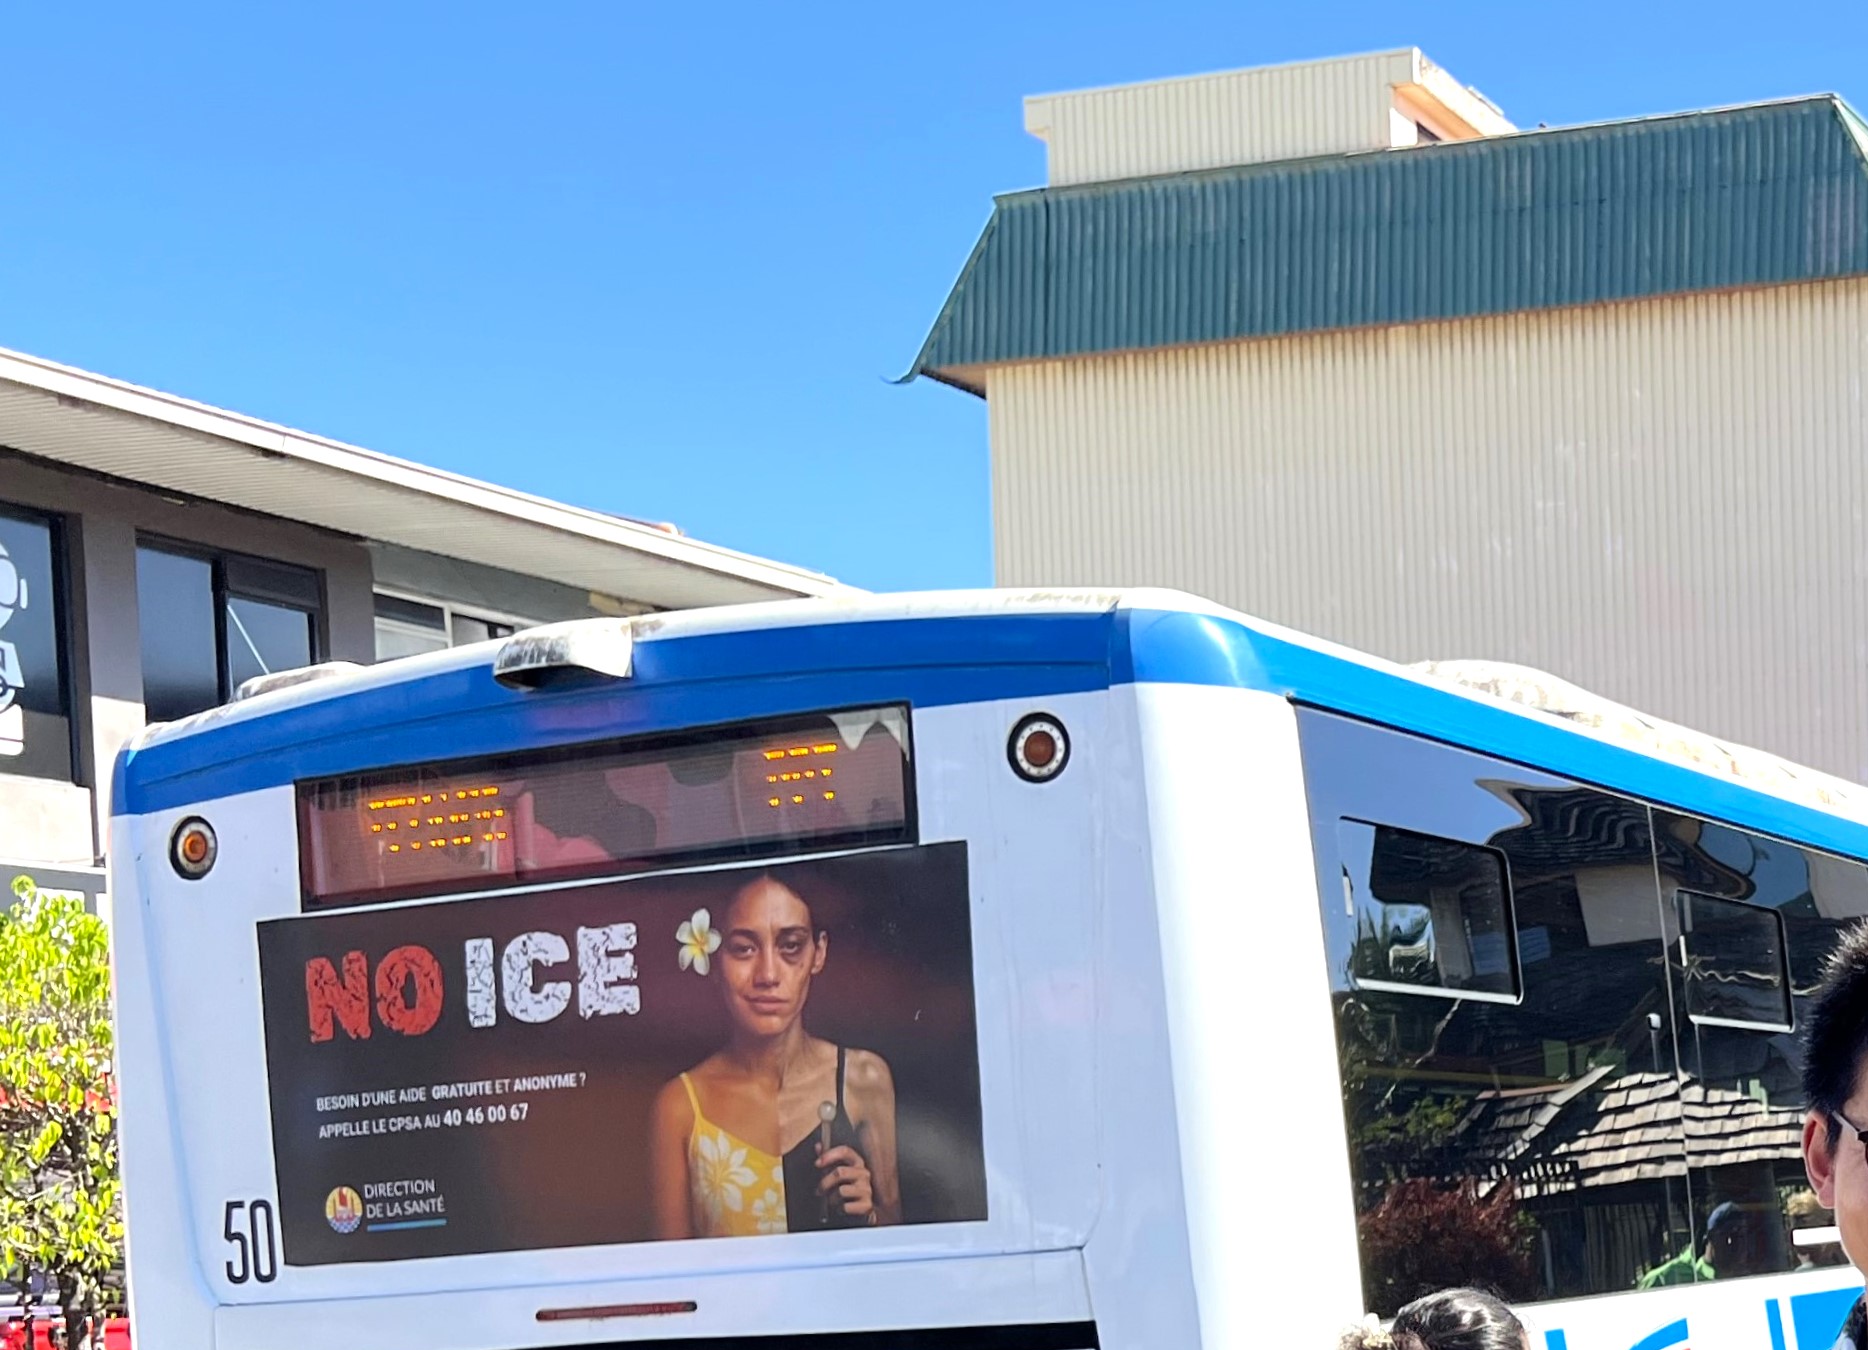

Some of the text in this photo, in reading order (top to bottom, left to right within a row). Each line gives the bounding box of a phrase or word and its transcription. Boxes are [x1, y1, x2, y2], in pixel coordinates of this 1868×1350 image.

[305, 922, 641, 1043] NO ICE
[316, 1093, 360, 1112] BESOIN
[361, 1090, 397, 1108] D'UNE
[399, 1086, 427, 1103] AIDE
[431, 1079, 493, 1100] GRATUITE
[495, 1078, 511, 1094] ET
[513, 1072, 577, 1093] ANONYME
[318, 1102, 529, 1139] APPELLE LE CPSA AU 40 46 00 67
[364, 1179, 436, 1199] DIRECTION
[366, 1193, 446, 1219] DE LA SANTÉ
[223, 1198, 278, 1285] 50
